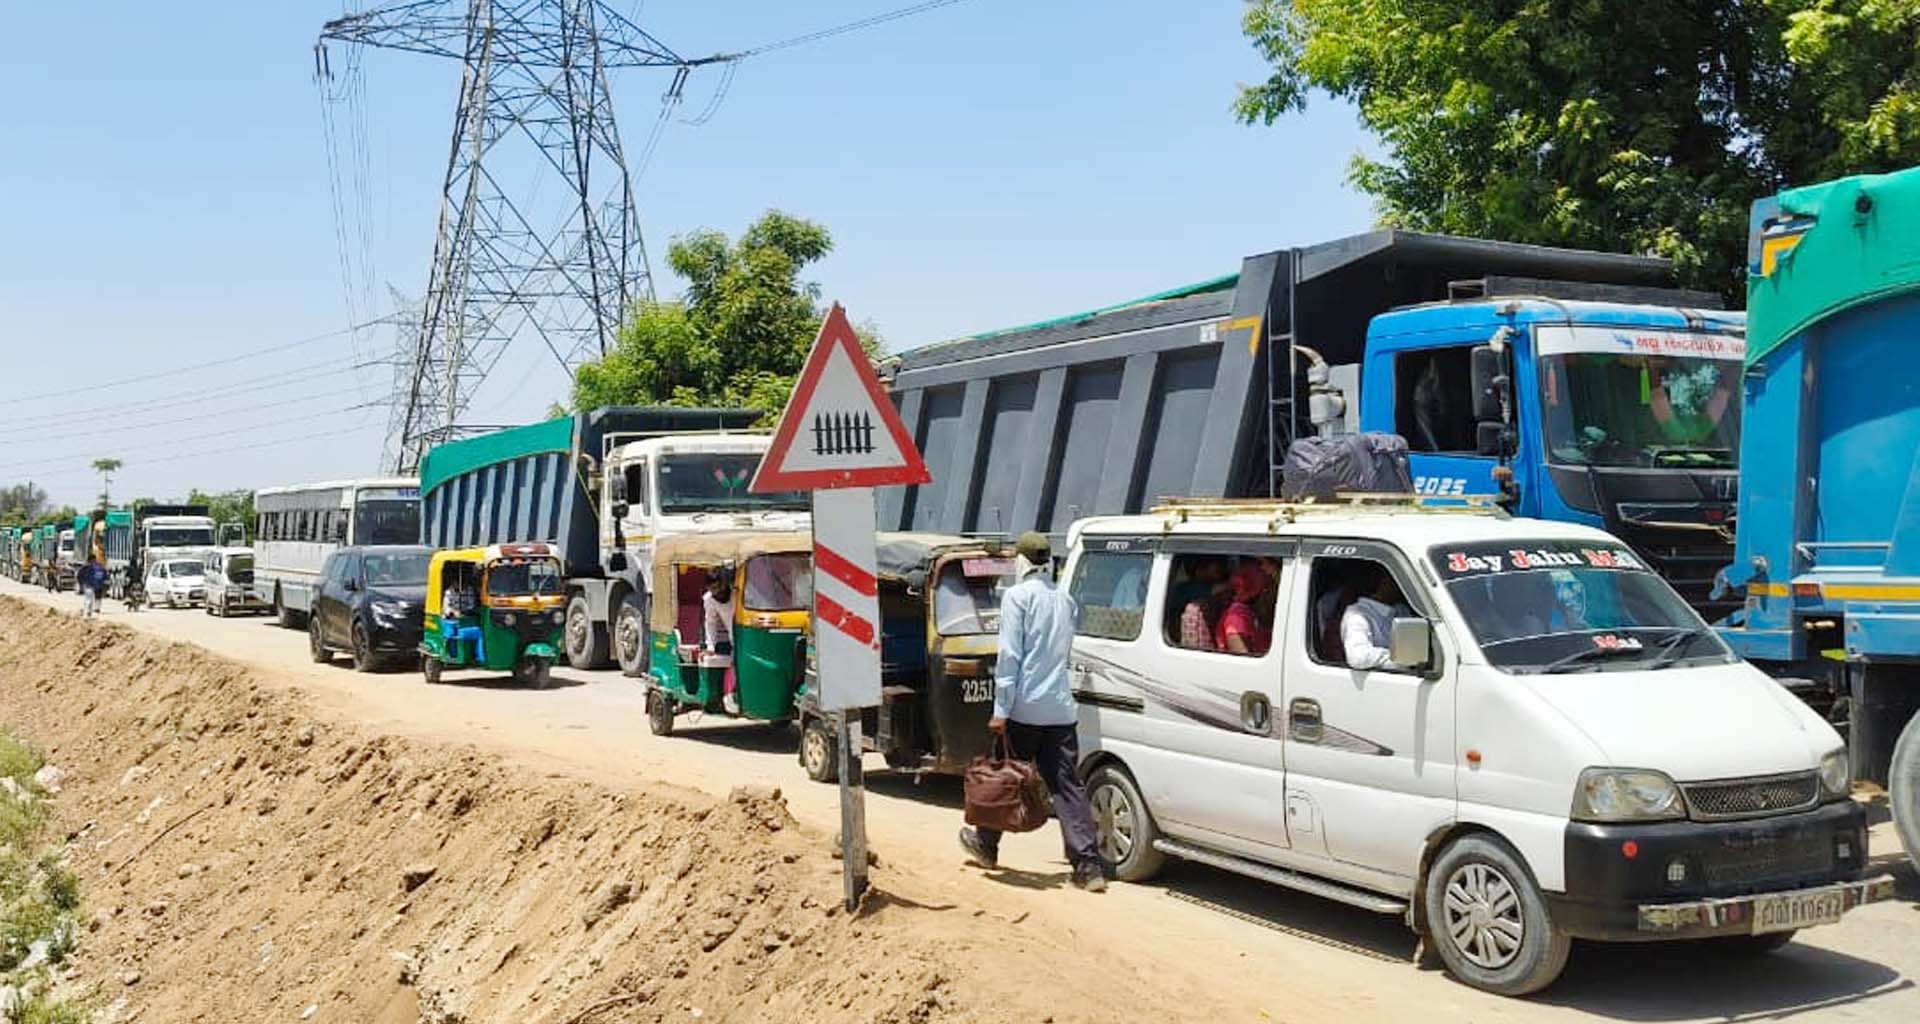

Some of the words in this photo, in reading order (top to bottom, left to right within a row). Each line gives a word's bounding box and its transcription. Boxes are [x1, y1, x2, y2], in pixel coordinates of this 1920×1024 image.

[1414, 476, 1467, 496] 2025
[1447, 553, 1502, 573] Jay
[1509, 549, 1583, 569] Jahu
